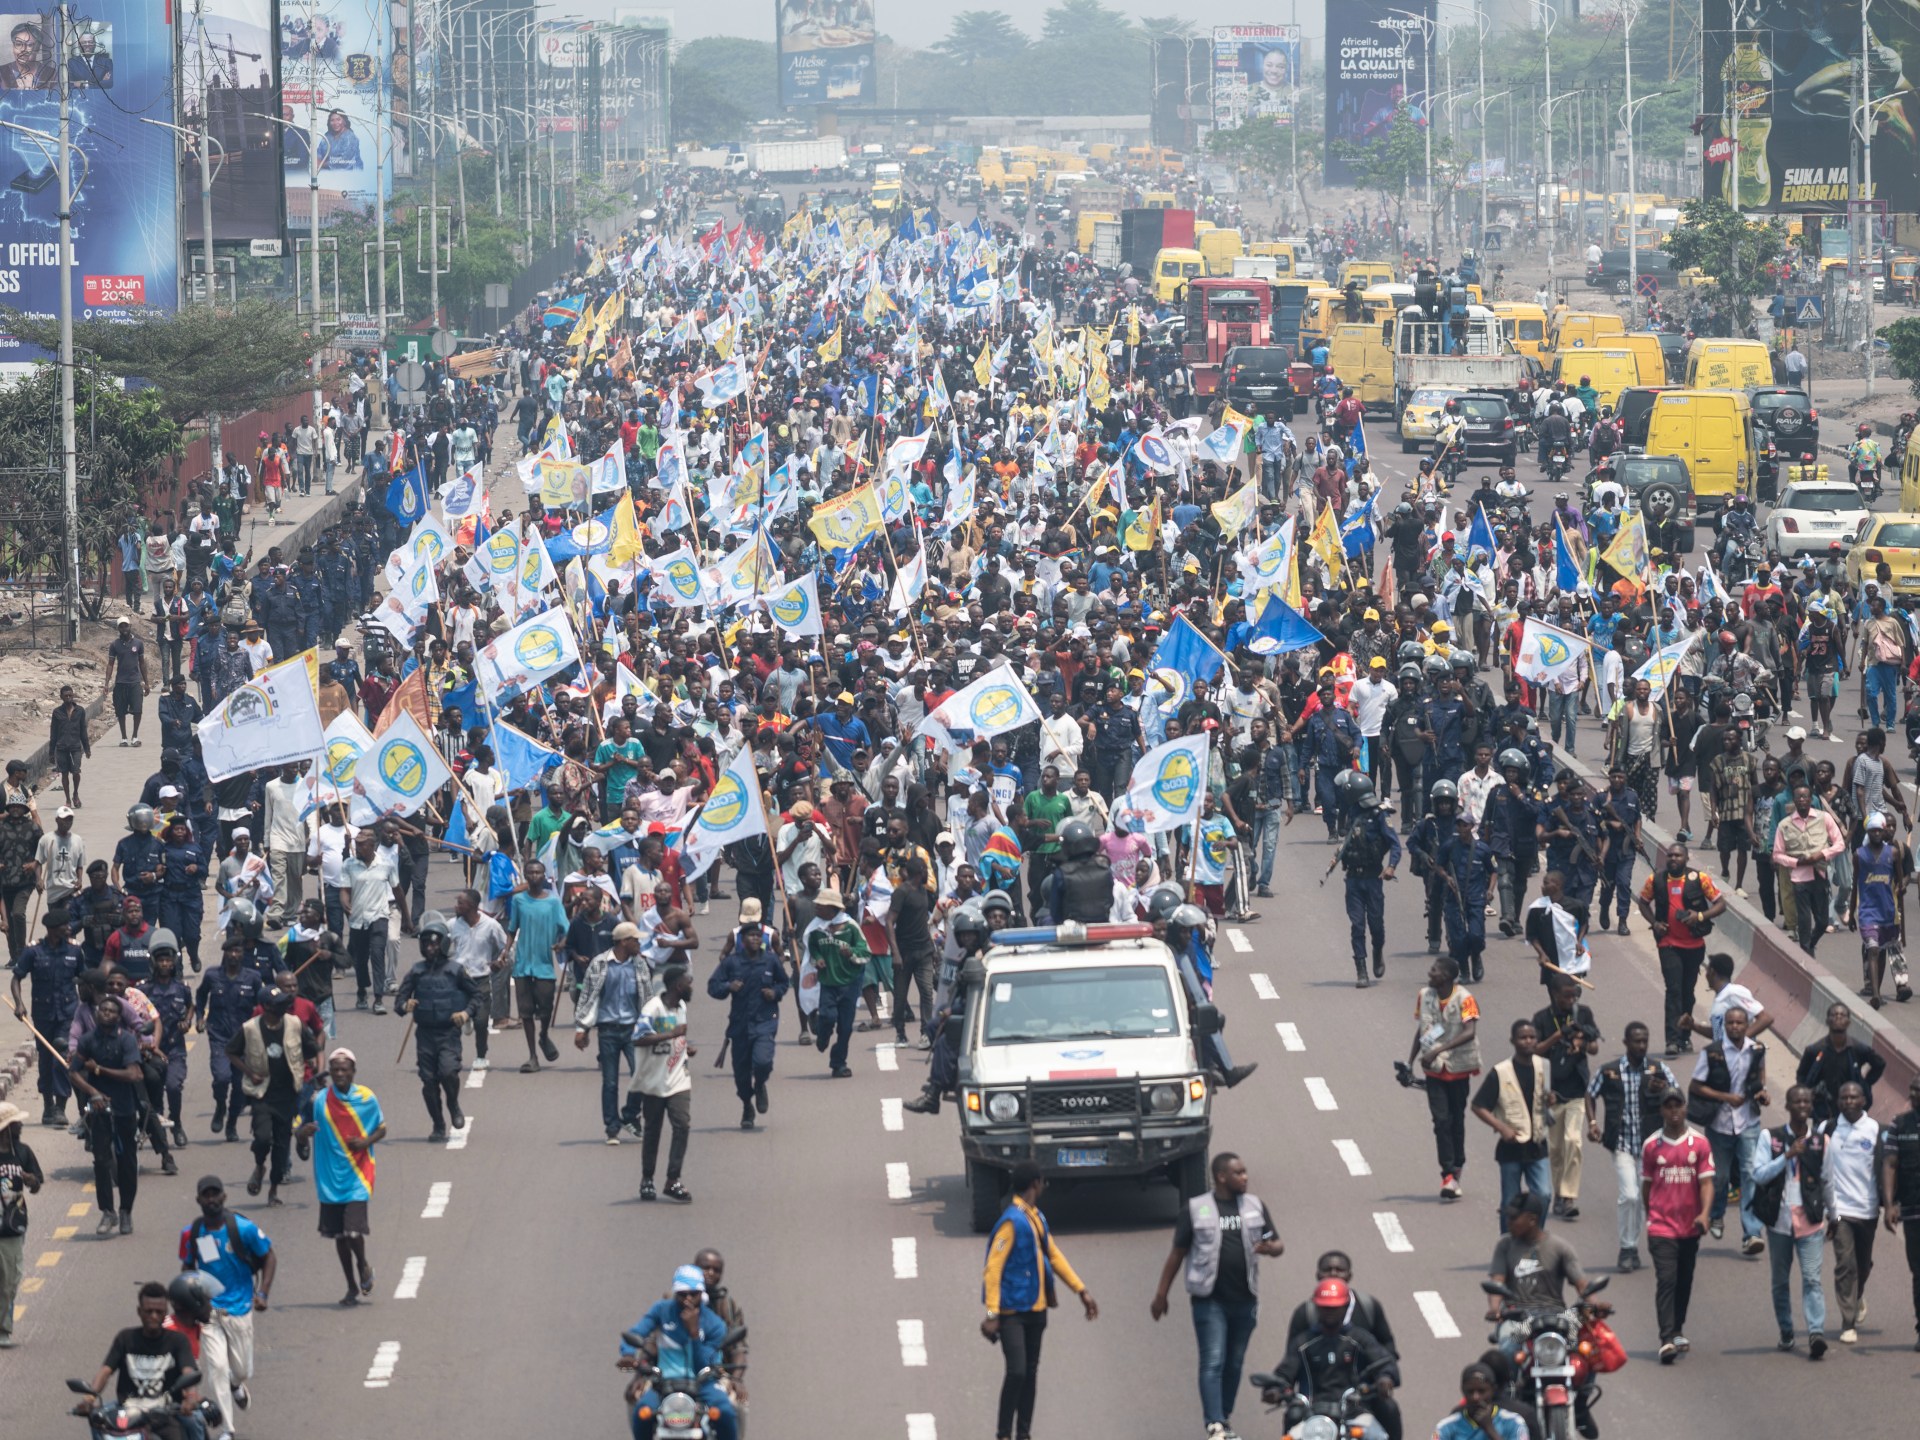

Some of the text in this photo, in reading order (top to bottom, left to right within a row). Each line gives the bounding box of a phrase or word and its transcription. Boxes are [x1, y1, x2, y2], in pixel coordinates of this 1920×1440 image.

[1341, 44, 1403, 58] OPTIMISÉ
[1341, 56, 1415, 71] LA QUALITÉ
[1340, 71, 1351, 79] de
[1784, 167, 1848, 186] SUKA NA
[9, 243, 79, 266] OFFICIL
[101, 279, 141, 289] 13 Juin
[102, 291, 134, 301] 2026
[96, 309, 126, 317] Centre
[1518, 392, 1528, 403] 13
[1061, 1096, 1109, 1108] TOYOTA
